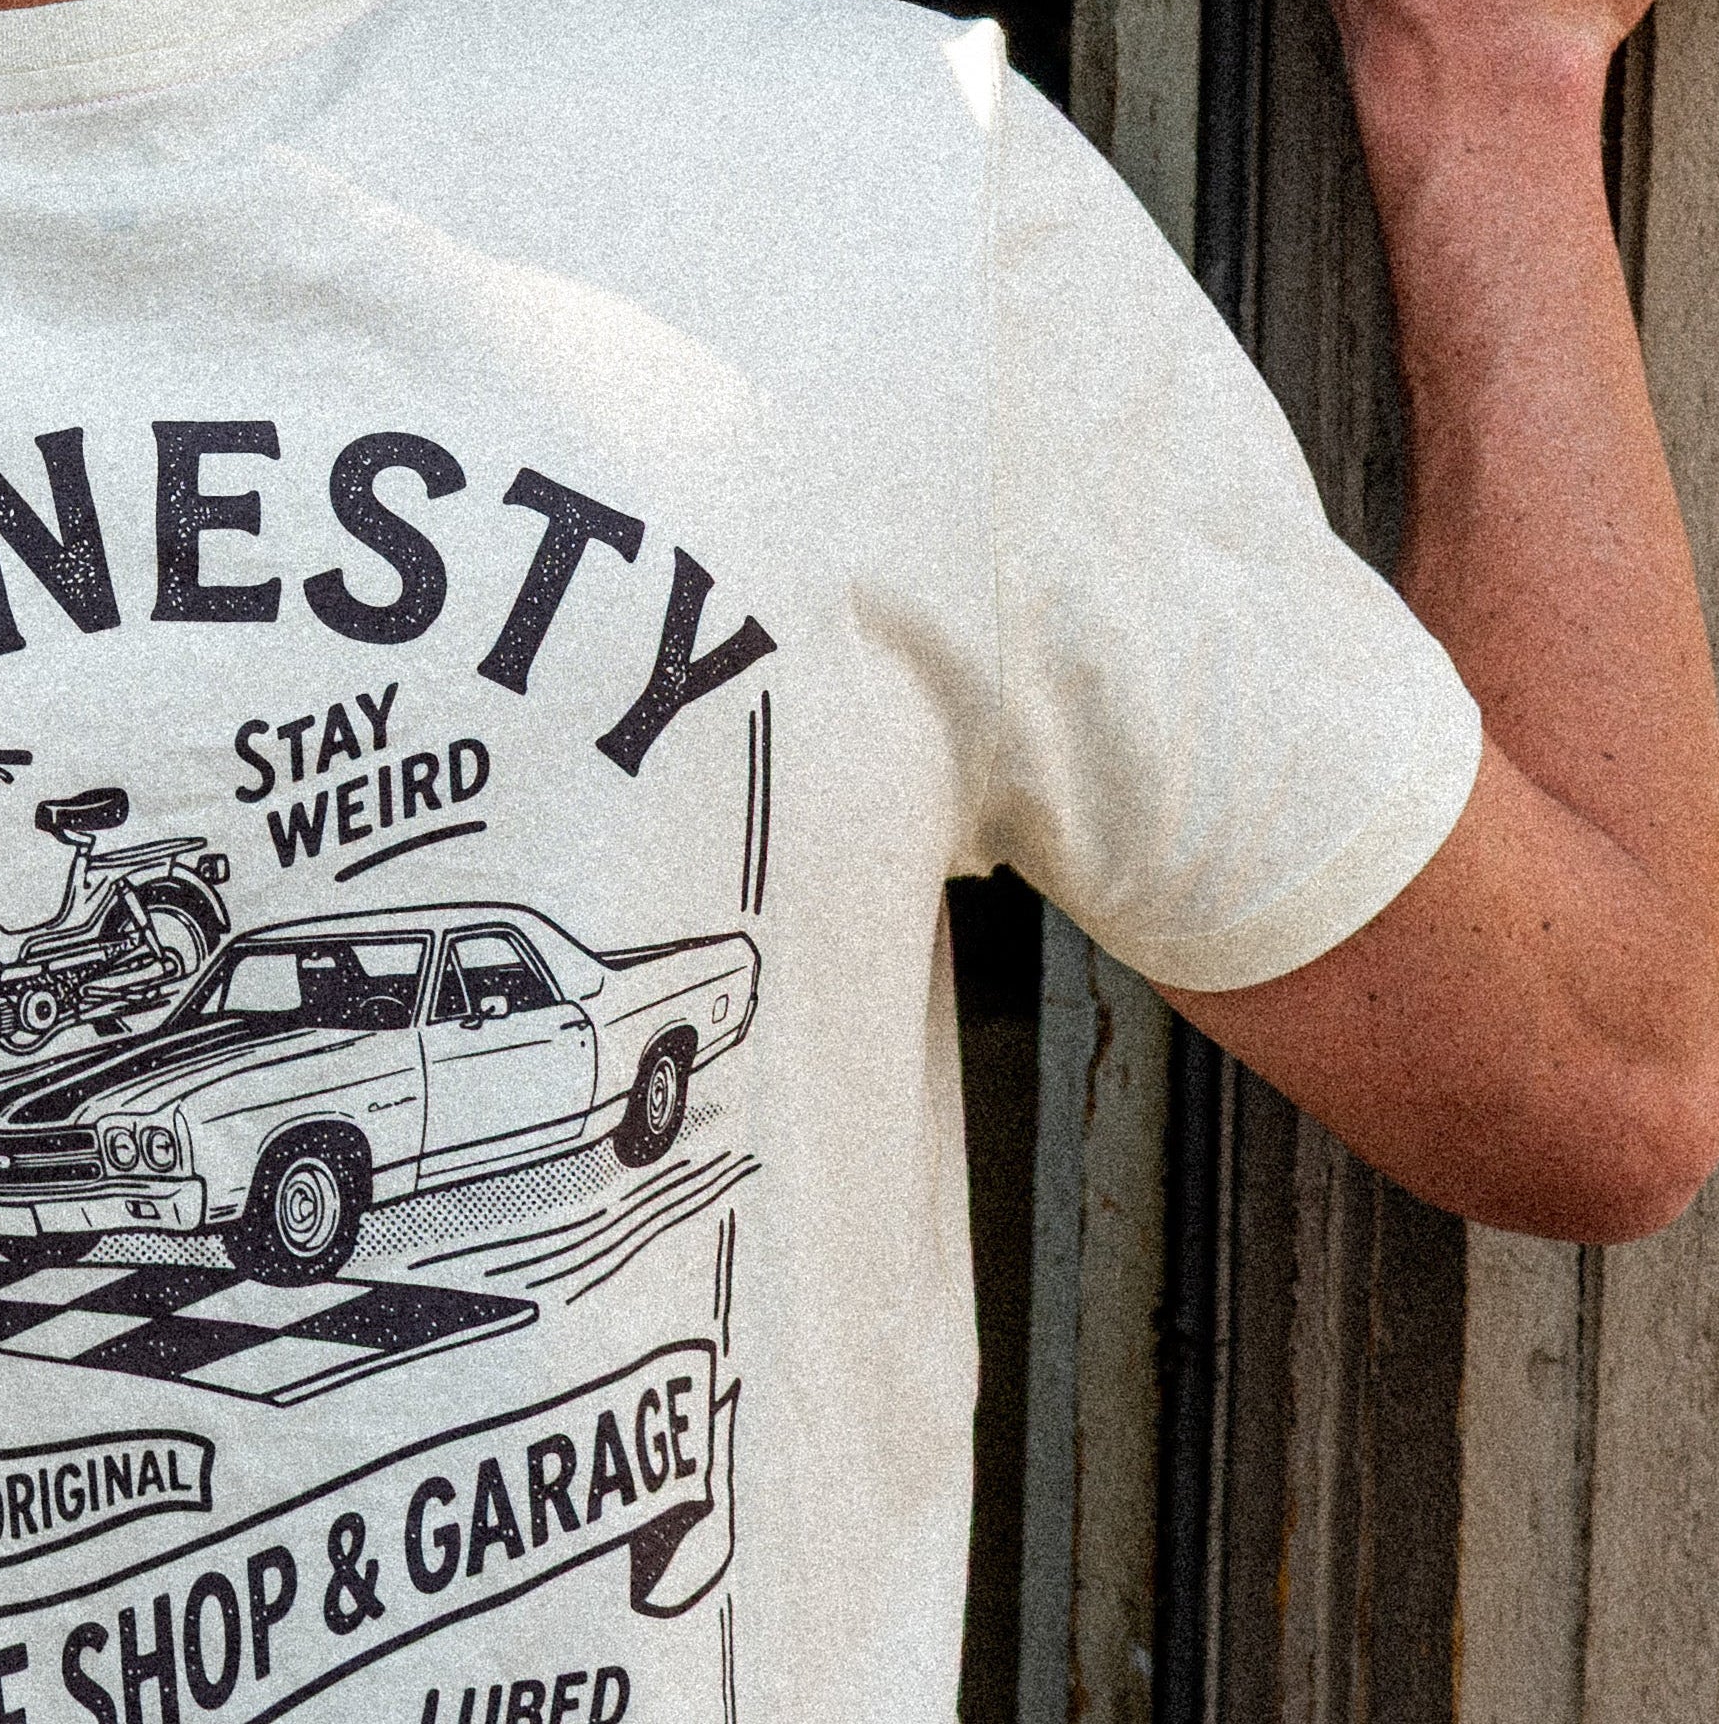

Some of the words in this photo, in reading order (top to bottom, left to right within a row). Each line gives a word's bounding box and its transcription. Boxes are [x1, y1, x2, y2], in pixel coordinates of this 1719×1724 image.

[234, 682, 399, 804] STAY
[267, 738, 491, 868] WEIRD
[62, 1544, 298, 1724] SHOP
[323, 1511, 386, 1636] &
[403, 1376, 697, 1594] GARAGE
